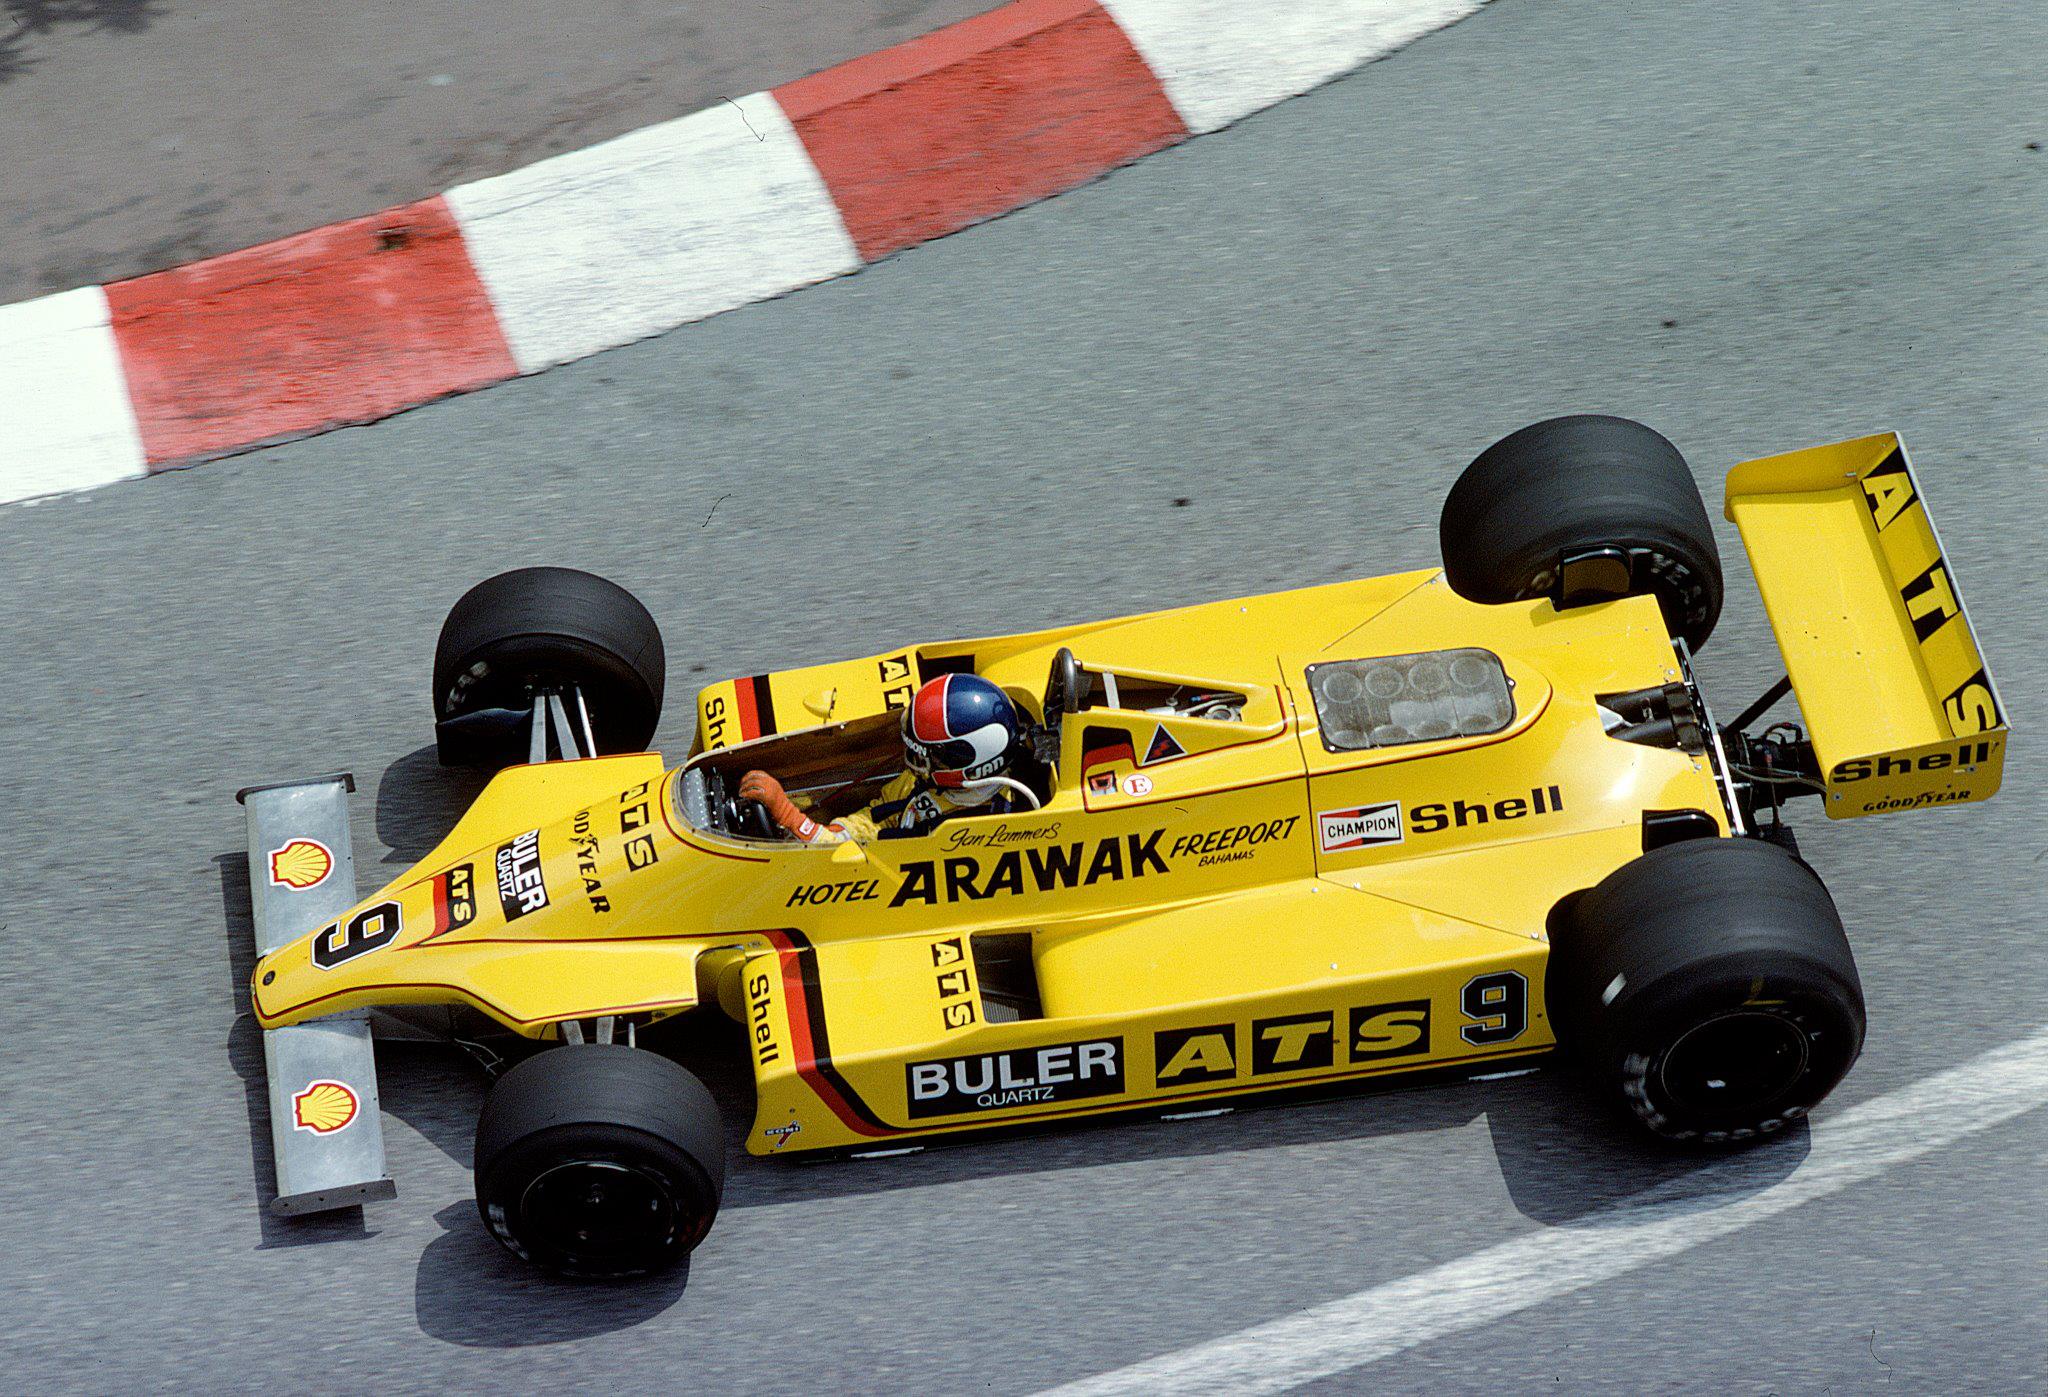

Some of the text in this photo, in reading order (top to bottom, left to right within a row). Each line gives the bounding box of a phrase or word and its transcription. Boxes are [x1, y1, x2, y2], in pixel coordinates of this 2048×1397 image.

[1862, 470, 1998, 735] ATS
[883, 660, 911, 708] AT
[705, 697, 727, 750] She
[1833, 742, 1989, 783] Shell
[1327, 816, 1398, 839] CHAMPION
[1411, 786, 1564, 835] Shell
[1863, 790, 1971, 812] GOODYEAR
[570, 809, 611, 914] ODYEAR
[785, 816, 1301, 909] HOTEL ARAWAK FREEPORT
[940, 828, 985, 852] Jan
[1198, 849, 1255, 867] BAHAMAS
[452, 869, 472, 922] ATS
[497, 848, 517, 902] QUARTZ
[511, 829, 547, 914] BULER
[312, 900, 404, 970] 9
[936, 941, 973, 1027] ATS
[1460, 969, 1529, 1047] 9
[749, 974, 780, 1066] Shell
[1155, 1009, 1427, 1080] ATS
[912, 1042, 1117, 1101] BULER
[977, 1086, 1055, 1108] QUARTZ
